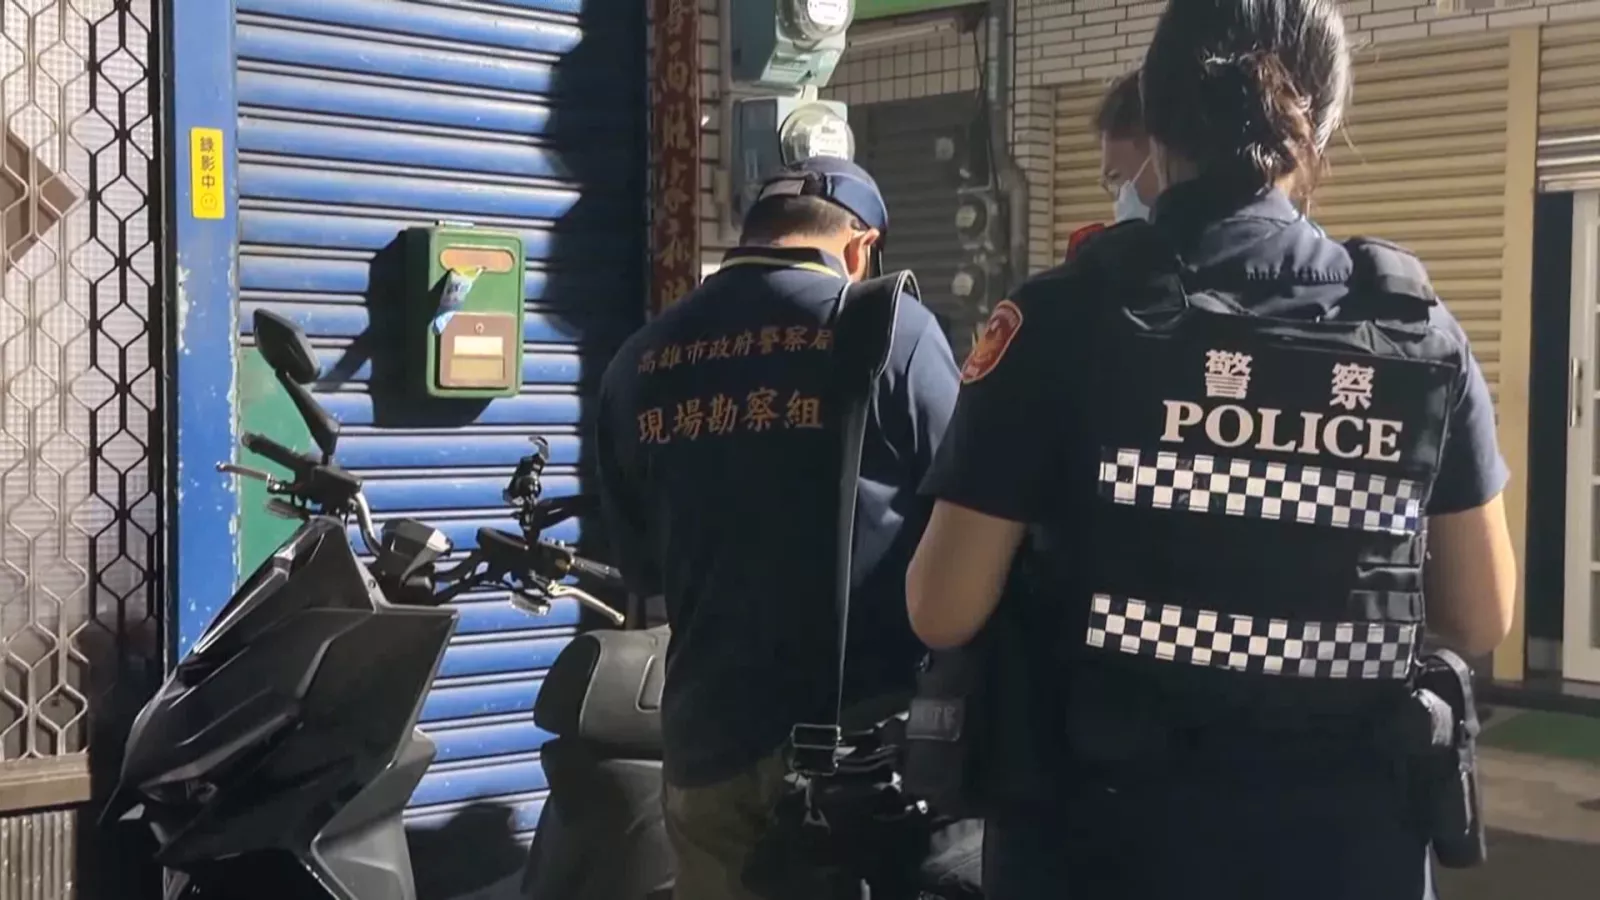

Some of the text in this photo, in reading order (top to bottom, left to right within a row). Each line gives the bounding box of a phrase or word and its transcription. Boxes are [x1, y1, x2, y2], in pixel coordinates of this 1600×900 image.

[200, 136, 215, 189] 錄影中
[637, 325, 834, 375] 高雄市政府警察局
[637, 387, 823, 444] 現場勘察組
[1160, 399, 1403, 463] POLICE
